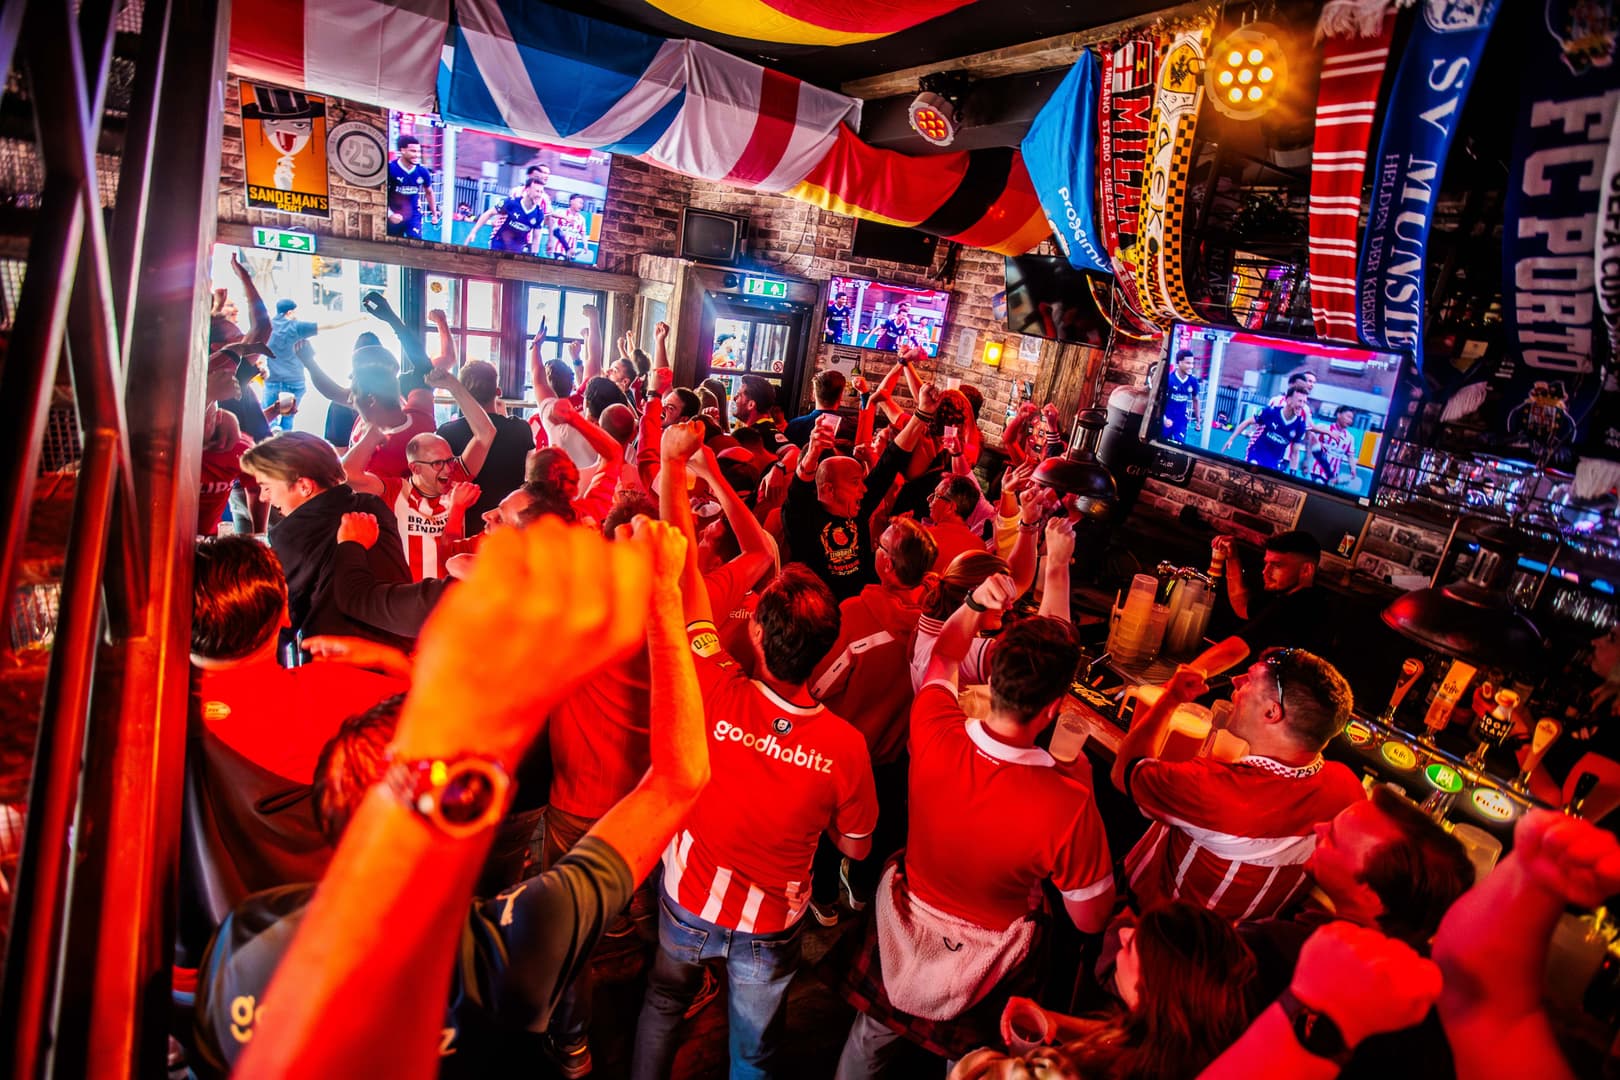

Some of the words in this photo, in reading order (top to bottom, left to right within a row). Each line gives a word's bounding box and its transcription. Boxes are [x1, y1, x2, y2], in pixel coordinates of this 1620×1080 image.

[1102, 67, 1113, 113] MILANO
[1419, 57, 1470, 138] SV
[1102, 120, 1112, 162] STADIO
[1112, 96, 1151, 235] MILAN
[1522, 88, 1618, 197] FC
[249, 187, 328, 210] SANDEMAN'S
[277, 202, 303, 213] PORT
[1103, 168, 1117, 223] G.MEAZZA
[1375, 154, 1400, 230] HELDEN
[1367, 236, 1385, 272] DER
[1515, 212, 1600, 374] PORTO
[713, 720, 833, 774] goodhabitz
